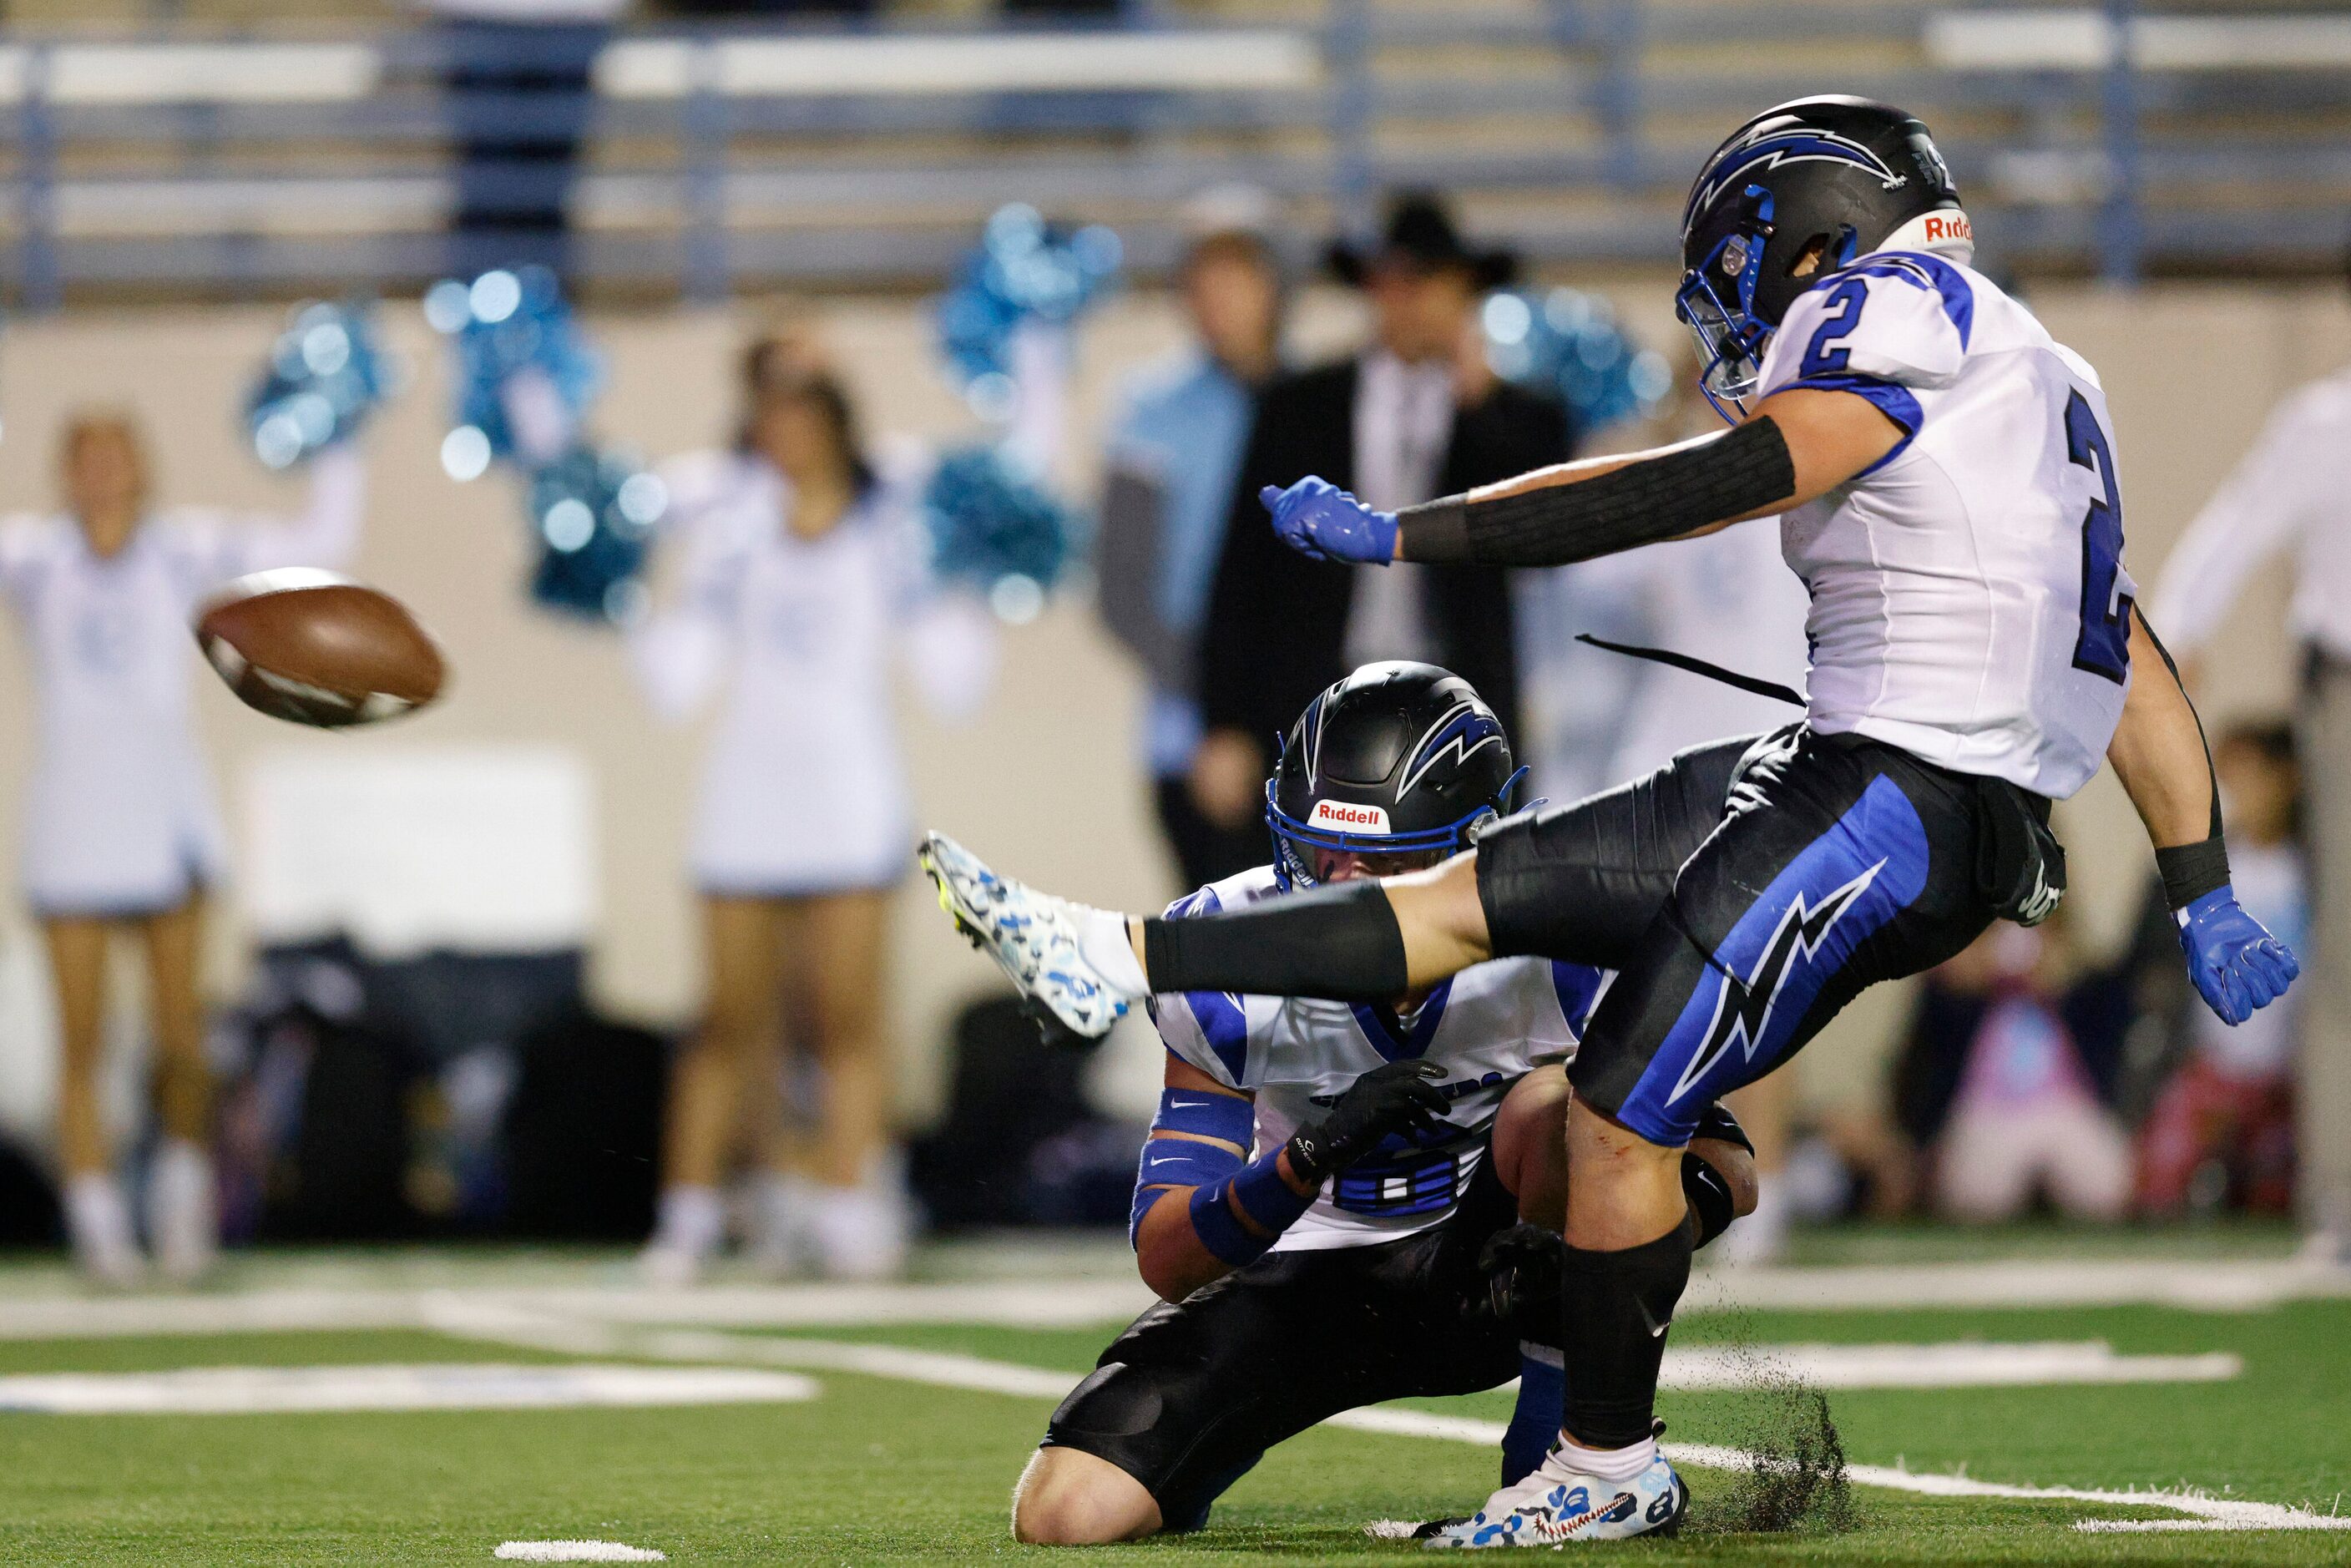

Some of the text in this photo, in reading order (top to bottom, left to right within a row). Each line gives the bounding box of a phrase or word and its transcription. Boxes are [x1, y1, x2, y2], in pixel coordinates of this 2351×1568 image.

[1798, 278, 1869, 379] 2
[2065, 383, 2133, 686] 2
[1319, 804, 1379, 825] Riddell
[1281, 837, 1315, 888] Riddell
